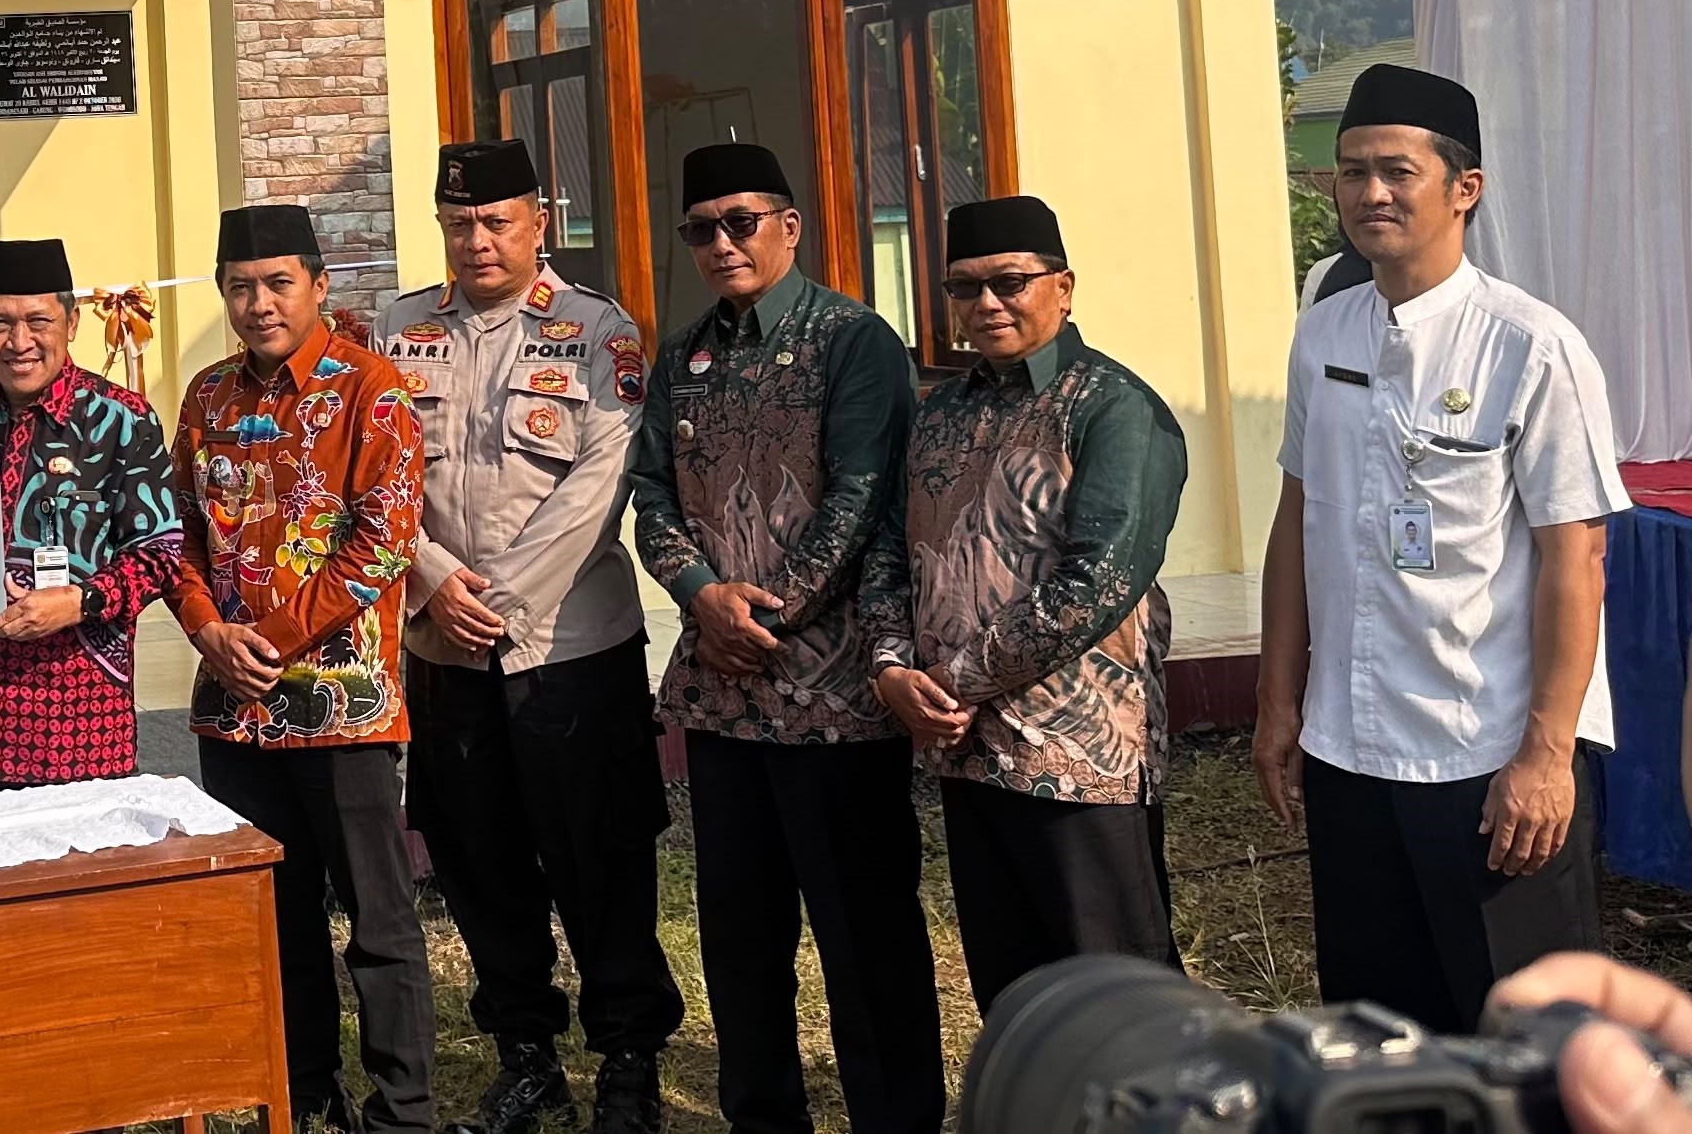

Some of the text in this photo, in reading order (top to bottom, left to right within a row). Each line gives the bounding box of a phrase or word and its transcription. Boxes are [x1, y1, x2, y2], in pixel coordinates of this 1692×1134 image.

[22, 84, 96, 97] AL WALIDAIN
[389, 343, 448, 358] ANRI
[524, 343, 586, 358] POLRI
